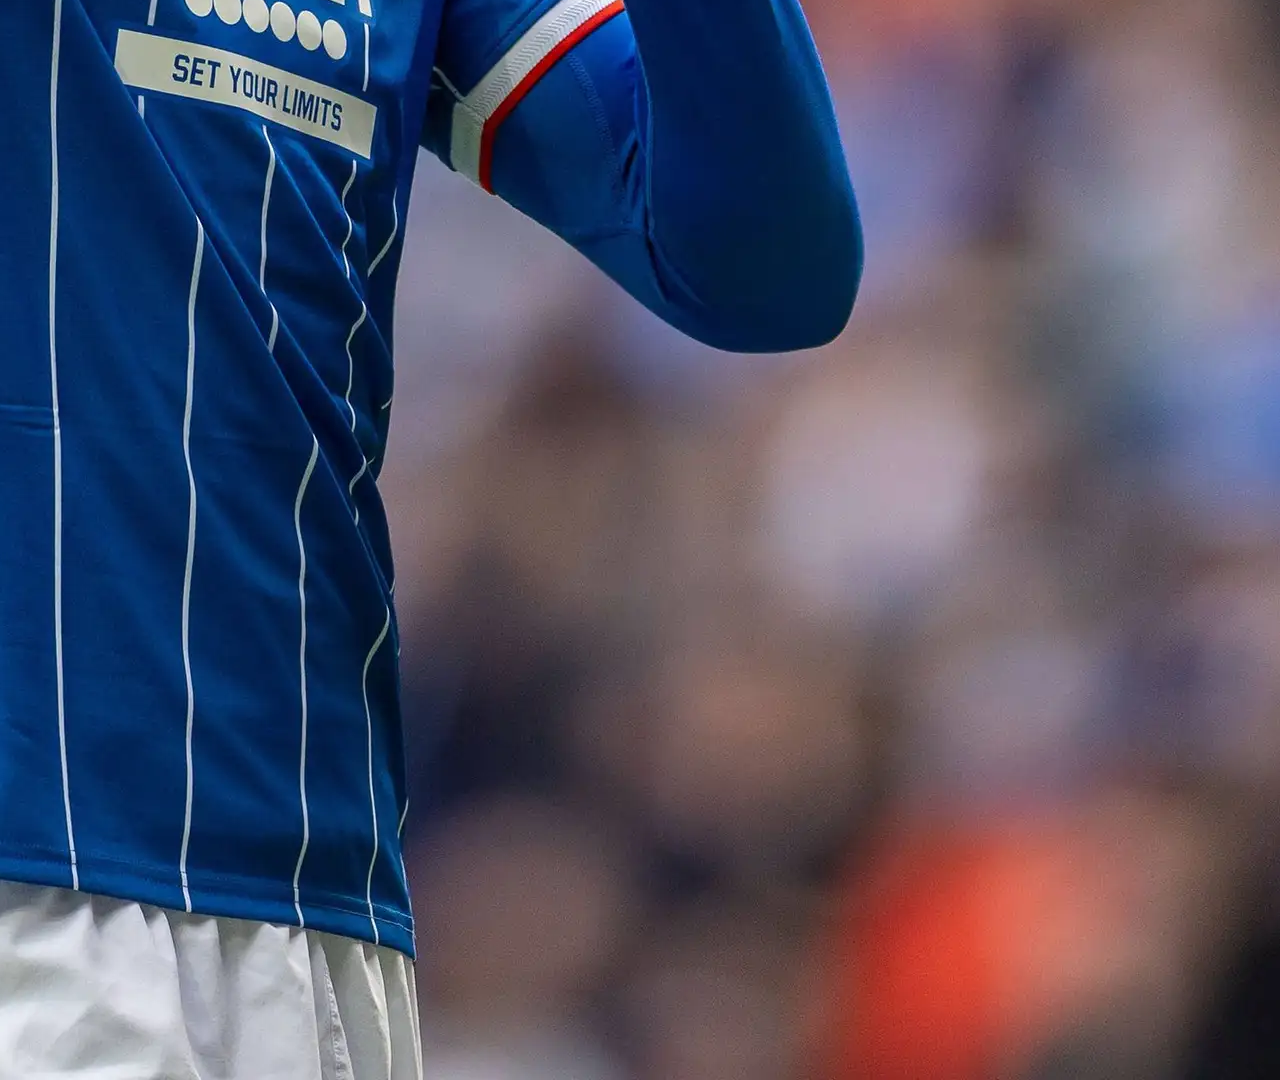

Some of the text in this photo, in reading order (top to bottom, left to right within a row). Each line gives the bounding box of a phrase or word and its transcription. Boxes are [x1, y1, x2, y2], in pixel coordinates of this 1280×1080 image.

[172, 54, 343, 132] SET YOUR LIMITS
